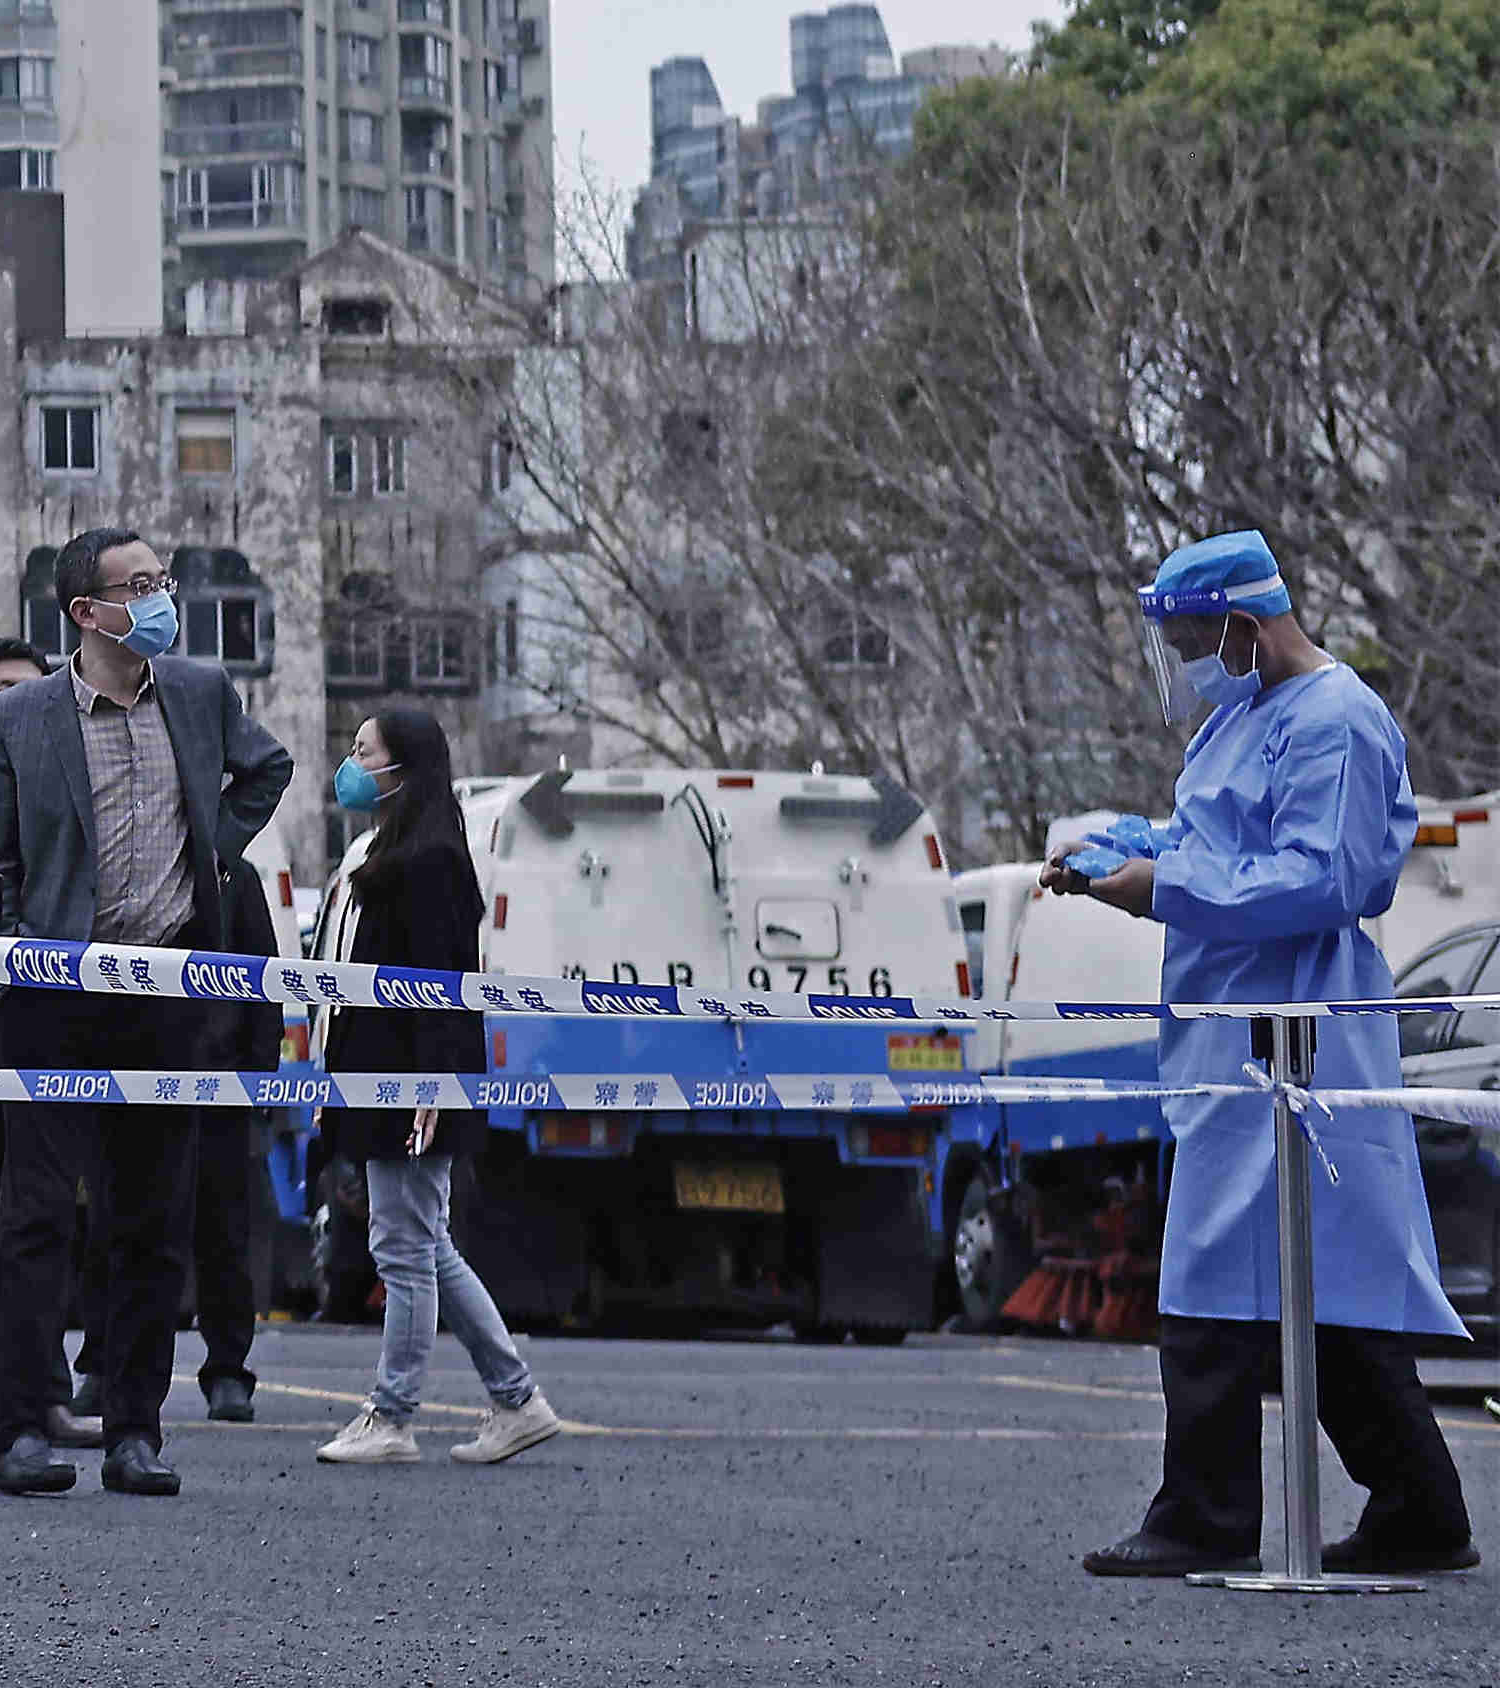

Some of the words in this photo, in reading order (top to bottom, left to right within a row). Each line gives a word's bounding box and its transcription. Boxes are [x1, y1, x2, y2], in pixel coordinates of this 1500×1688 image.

[13, 948, 78, 987] POLICE
[187, 963, 262, 1000] POLICE
[377, 978, 457, 1010] POLICE
